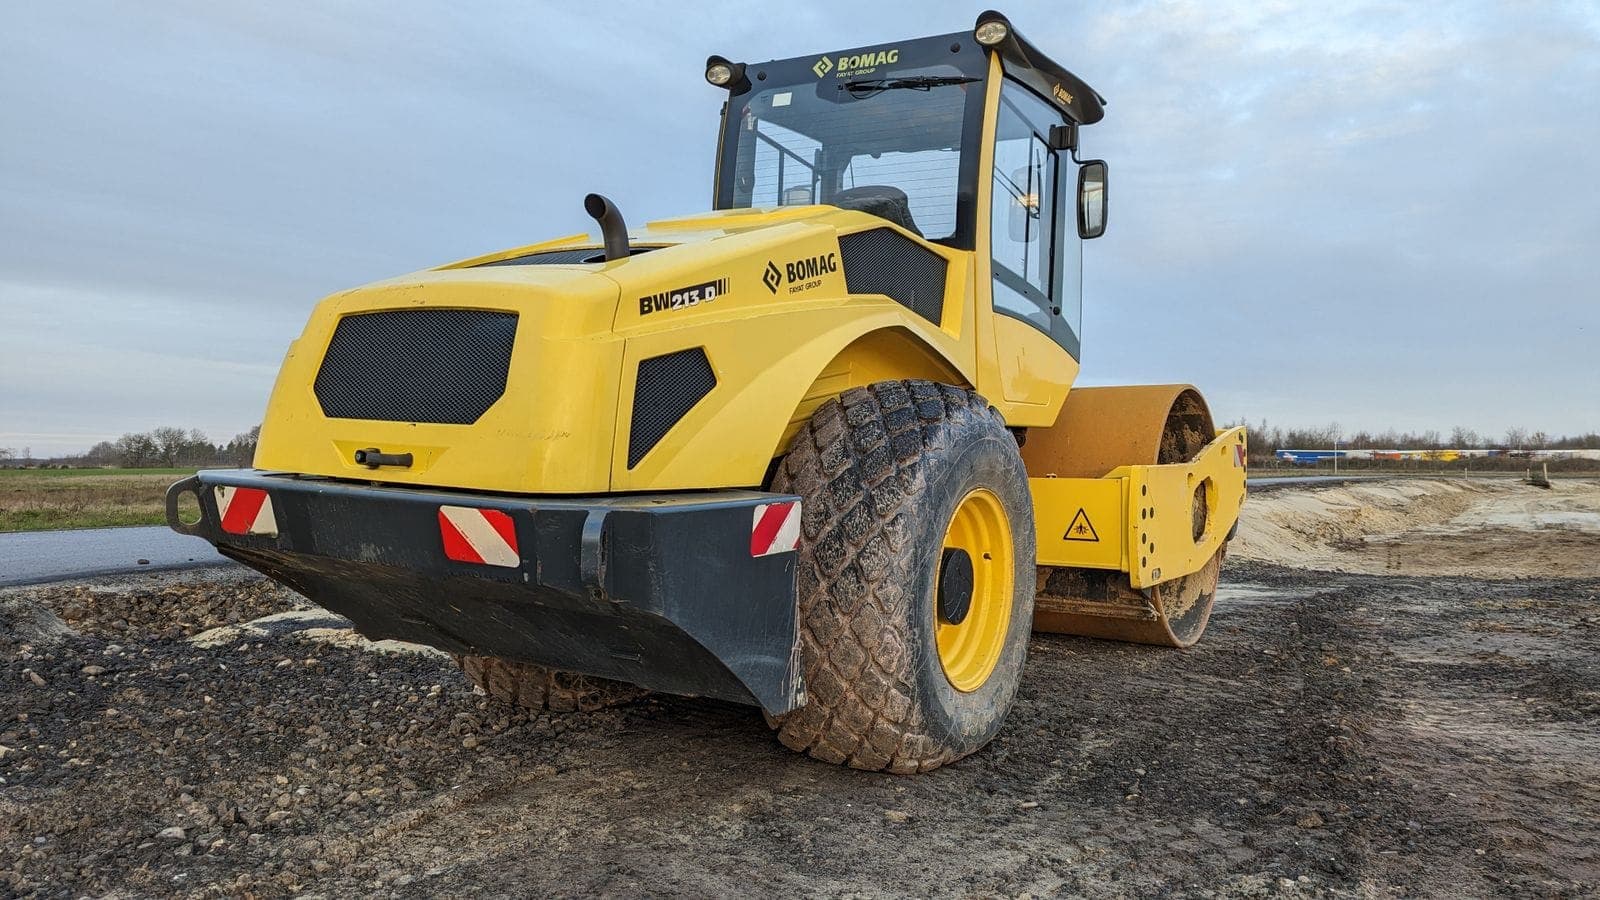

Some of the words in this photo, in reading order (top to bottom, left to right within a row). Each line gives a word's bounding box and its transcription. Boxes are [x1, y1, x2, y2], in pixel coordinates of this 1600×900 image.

[838, 50, 898, 71] BOMAG
[855, 68, 875, 76] GROUP
[1057, 88, 1073, 104] BOMAG
[786, 253, 837, 283] BOMAG
[704, 286, 717, 302] D
[789, 285, 804, 294] FAYAT
[805, 279, 822, 290] GROUP
